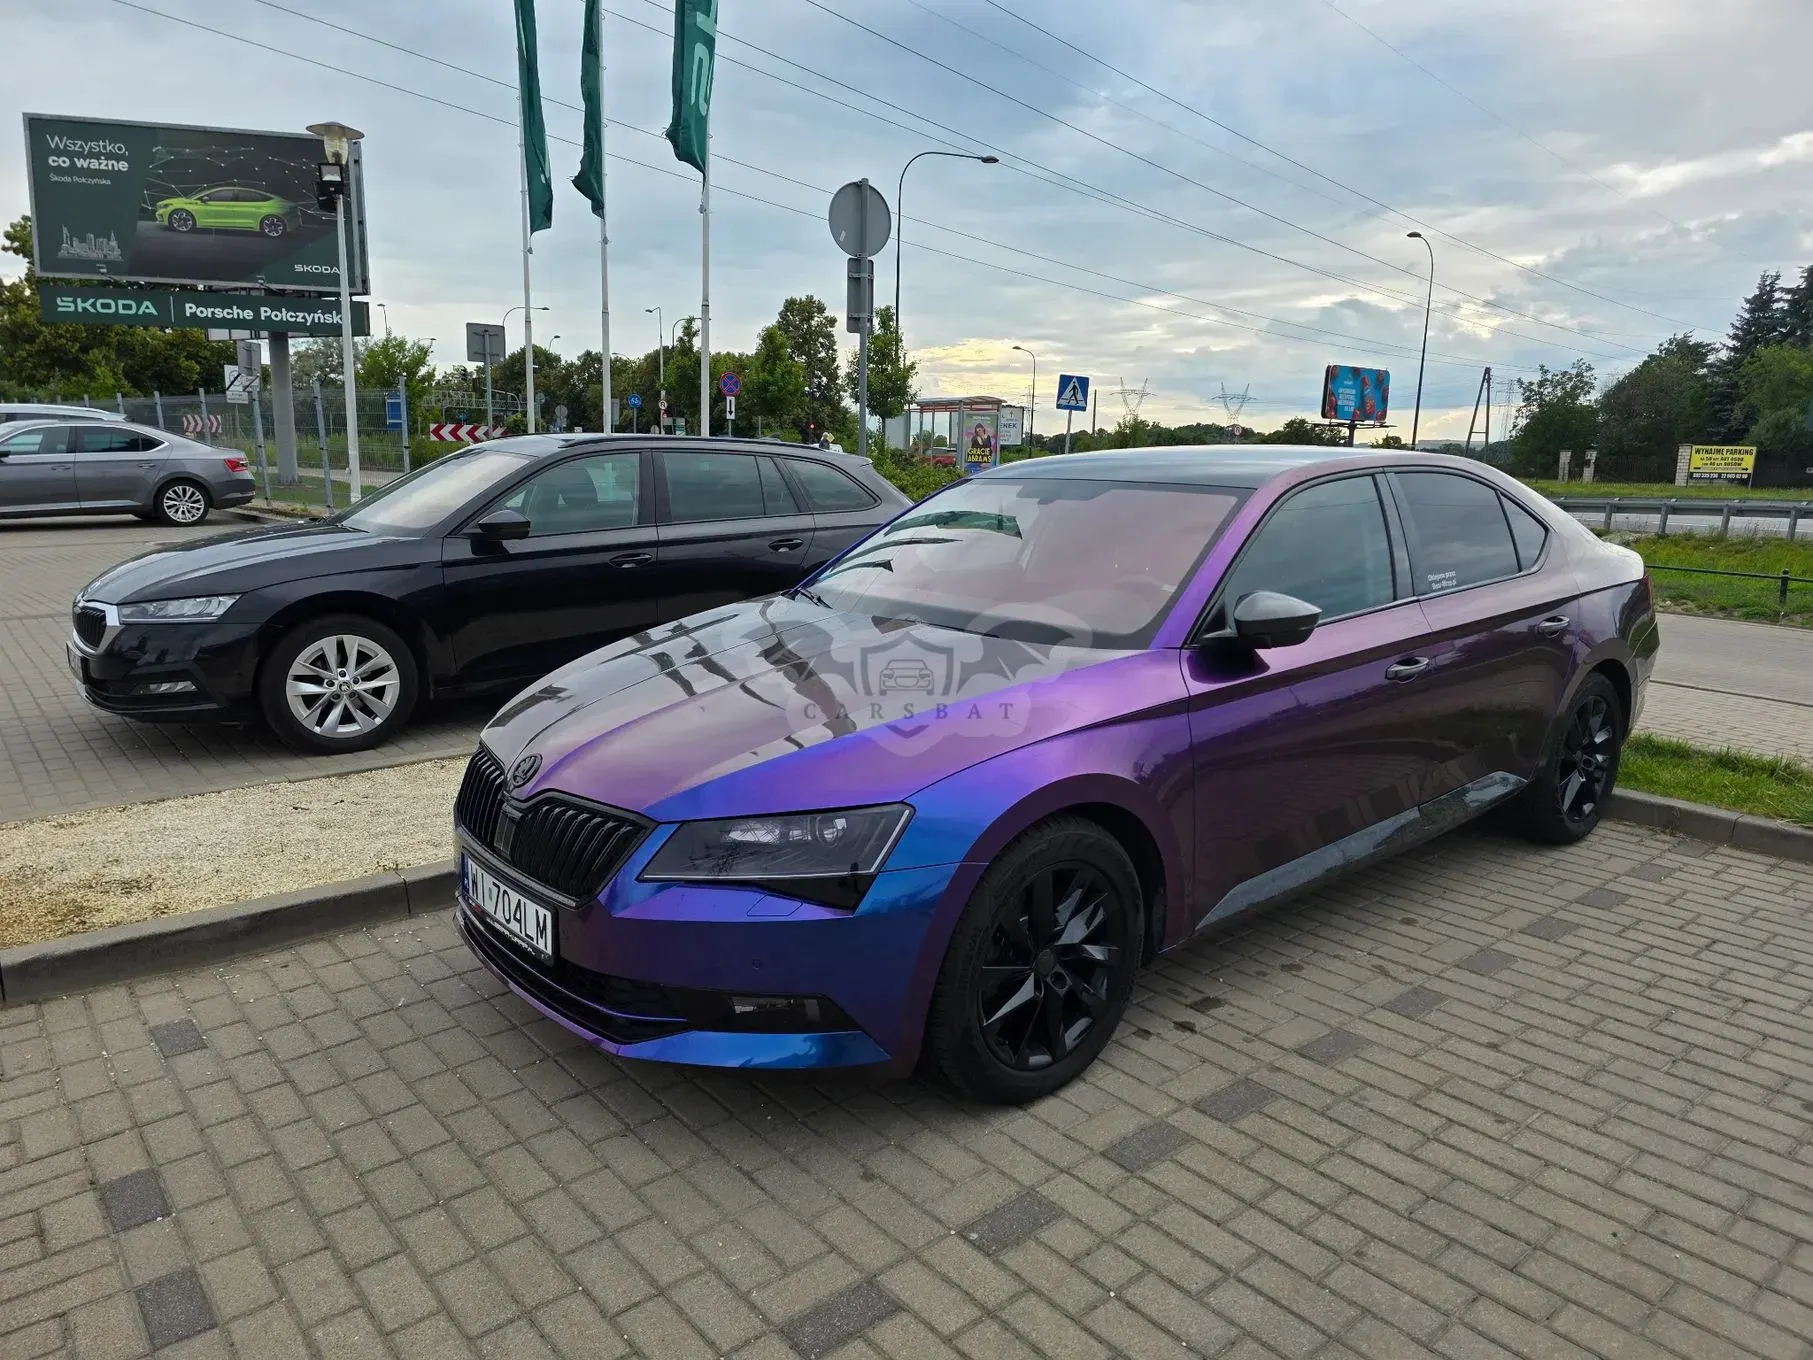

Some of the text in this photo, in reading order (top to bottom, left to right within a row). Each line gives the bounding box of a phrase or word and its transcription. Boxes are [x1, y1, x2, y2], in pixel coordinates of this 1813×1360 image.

[46, 134, 129, 156] Wszystko,
[48, 156, 129, 172] co ważne
[185, 303, 254, 320] Porsche
[260, 306, 343, 326] Połczyńsk
[470, 863, 484, 906] WI
[492, 880, 548, 951] 704LM
